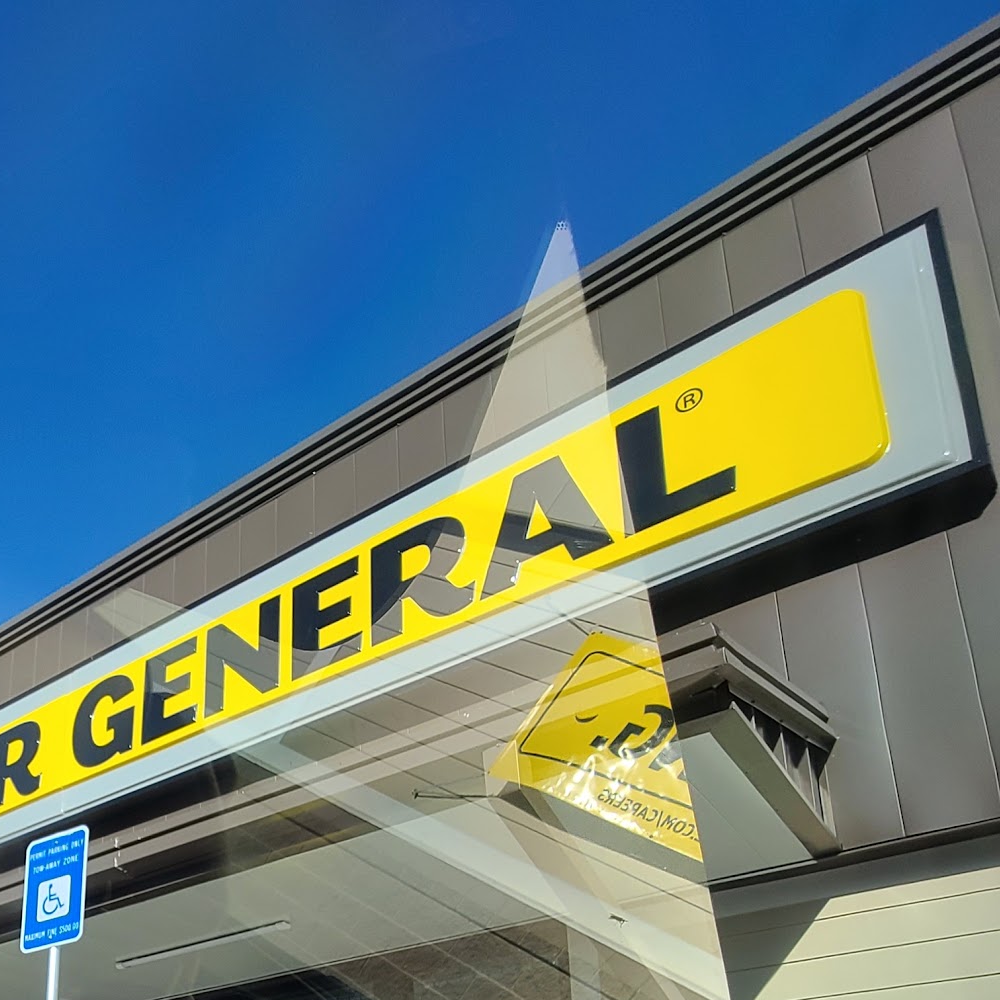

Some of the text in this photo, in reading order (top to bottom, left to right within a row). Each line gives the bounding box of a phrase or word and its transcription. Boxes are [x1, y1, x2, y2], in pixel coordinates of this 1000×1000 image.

[72, 405, 737, 769] GENERAL
[48, 843, 69, 856] PARKING
[71, 838, 84, 849] ONLY
[33, 853, 79, 875] TOW-AWAY ZONE
